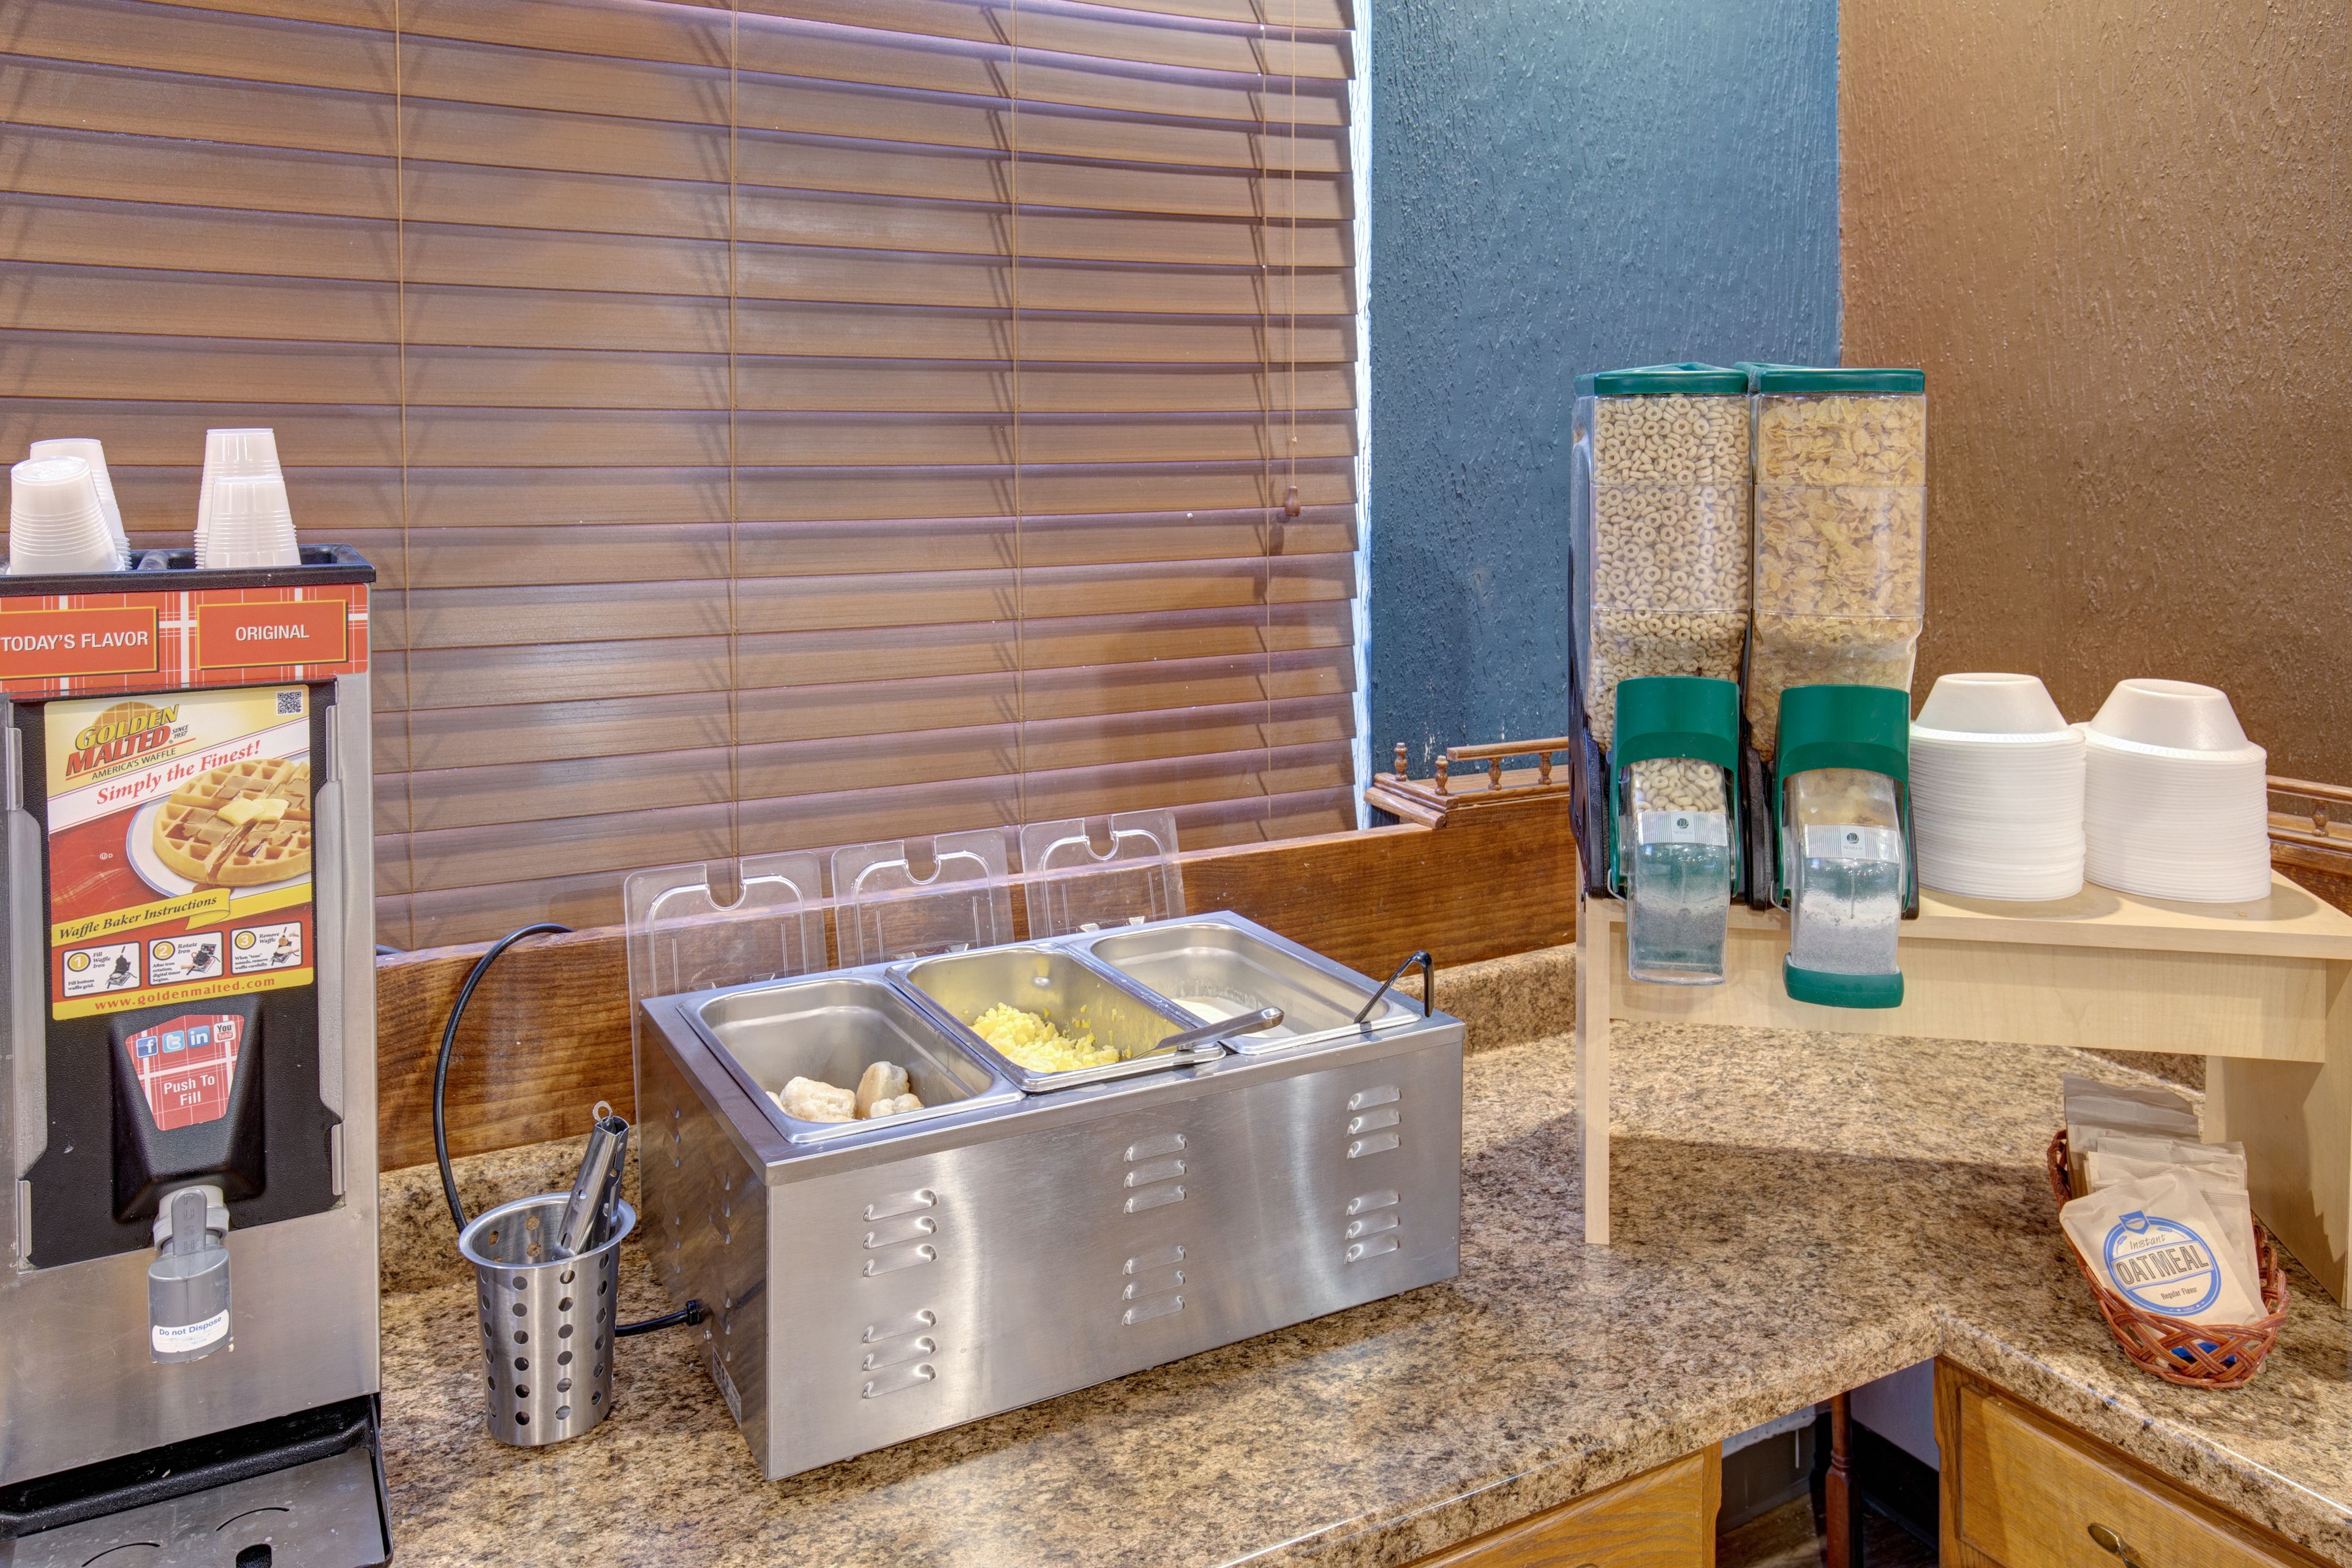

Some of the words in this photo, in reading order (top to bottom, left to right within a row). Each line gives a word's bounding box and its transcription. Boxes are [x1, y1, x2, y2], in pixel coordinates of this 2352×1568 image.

[235, 624, 310, 641] ORIGINAL
[0, 633, 76, 652] TODAY'S
[81, 631, 149, 648] FLAVOR
[75, 704, 179, 750] GOLDEN
[172, 724, 189, 734] SINCE
[173, 731, 188, 739] 1937
[66, 725, 171, 776] MALTED
[92, 759, 140, 780] AMERICA'S
[141, 747, 176, 764] WAFFLE
[97, 772, 162, 805] Simply
[167, 763, 195, 782] the
[198, 739, 261, 772] Finest!
[59, 922, 99, 940] Waffle
[102, 914, 141, 930] Baker
[143, 896, 217, 920] Instructions
[240, 934, 249, 946] 3
[159, 944, 168, 957] 2
[74, 956, 82, 968] 1
[94, 977, 276, 1010] www.goldenmalted.com
[217, 1023, 232, 1033] You
[218, 1031, 233, 1040] Tube
[190, 1030, 208, 1046] in
[164, 1078, 197, 1095] Push
[200, 1074, 216, 1087] To
[179, 1091, 202, 1106] Fill
[184, 1194, 195, 1251] PUSH
[2129, 1234, 2166, 1250] Instant
[2116, 1245, 2210, 1285] OATMEAL
[2160, 1288, 2181, 1300] Regular
[2181, 1286, 2198, 1295] Flavor
[189, 1316, 222, 1333] Dispose
